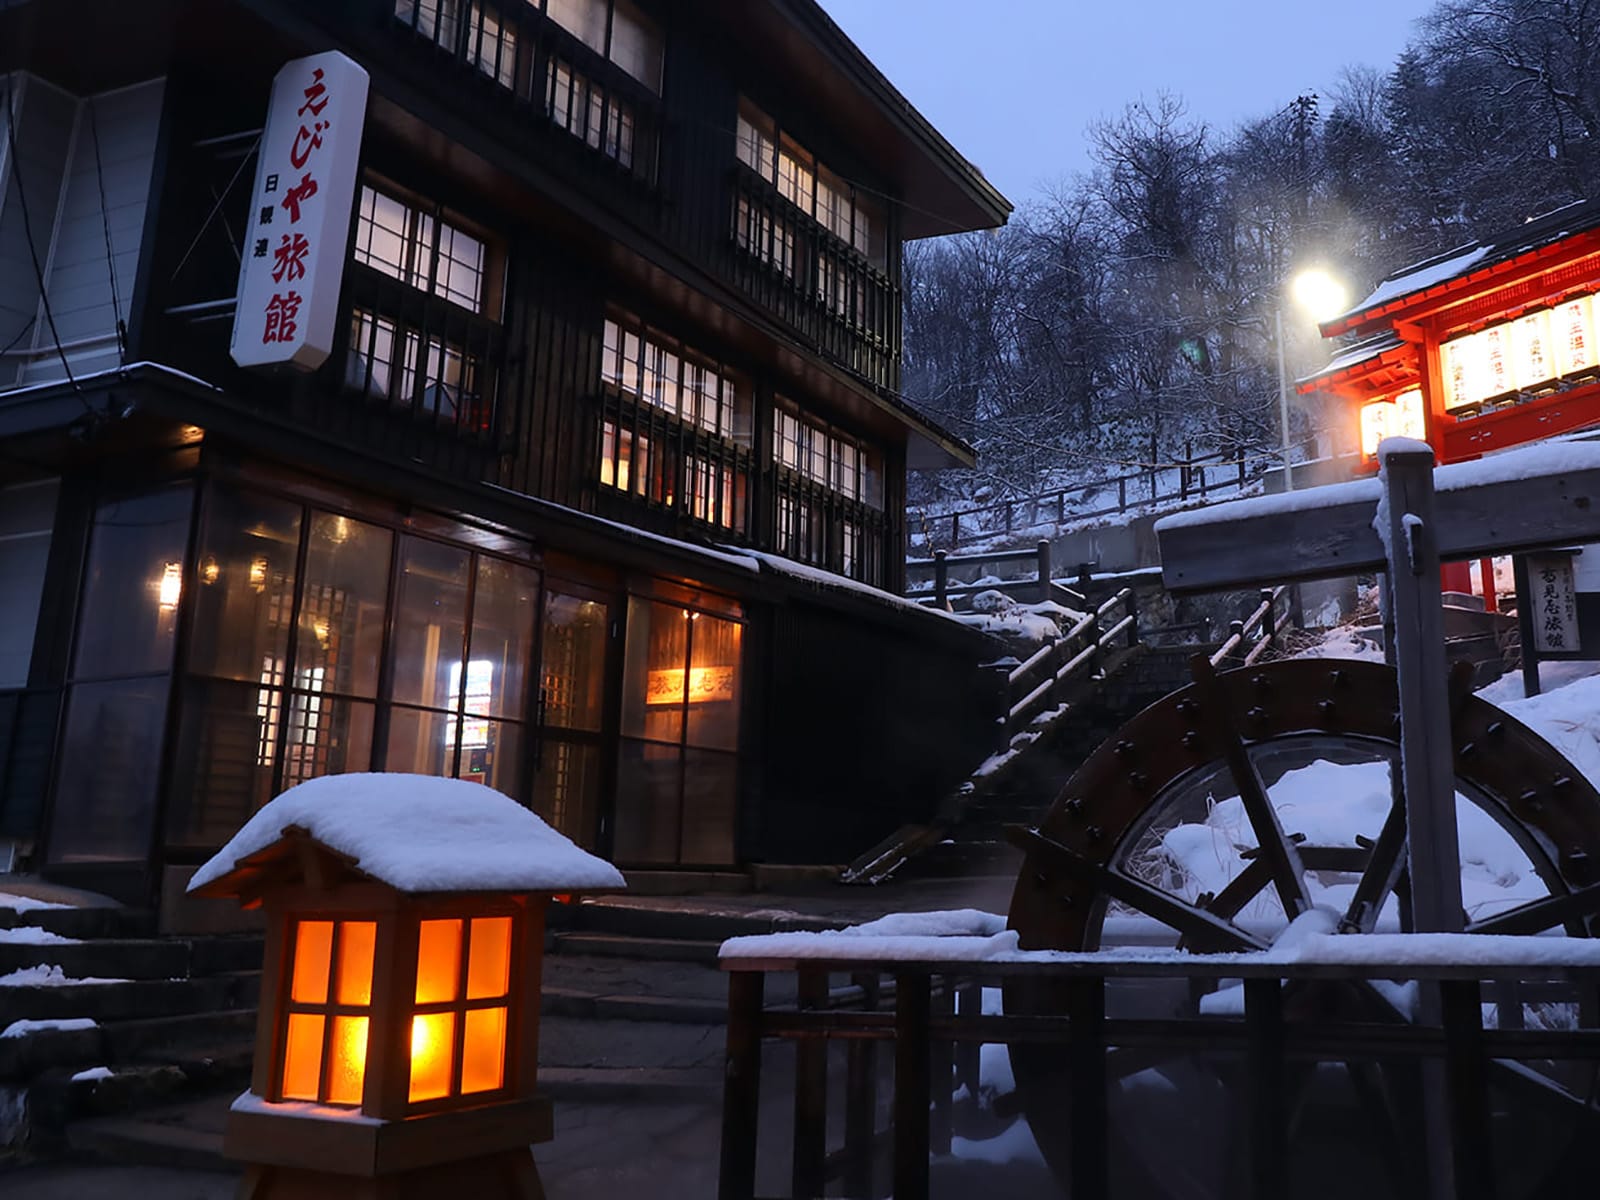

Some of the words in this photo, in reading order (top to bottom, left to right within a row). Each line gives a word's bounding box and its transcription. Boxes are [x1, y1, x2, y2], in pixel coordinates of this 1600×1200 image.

[262, 68, 329, 343] えびや旅館
